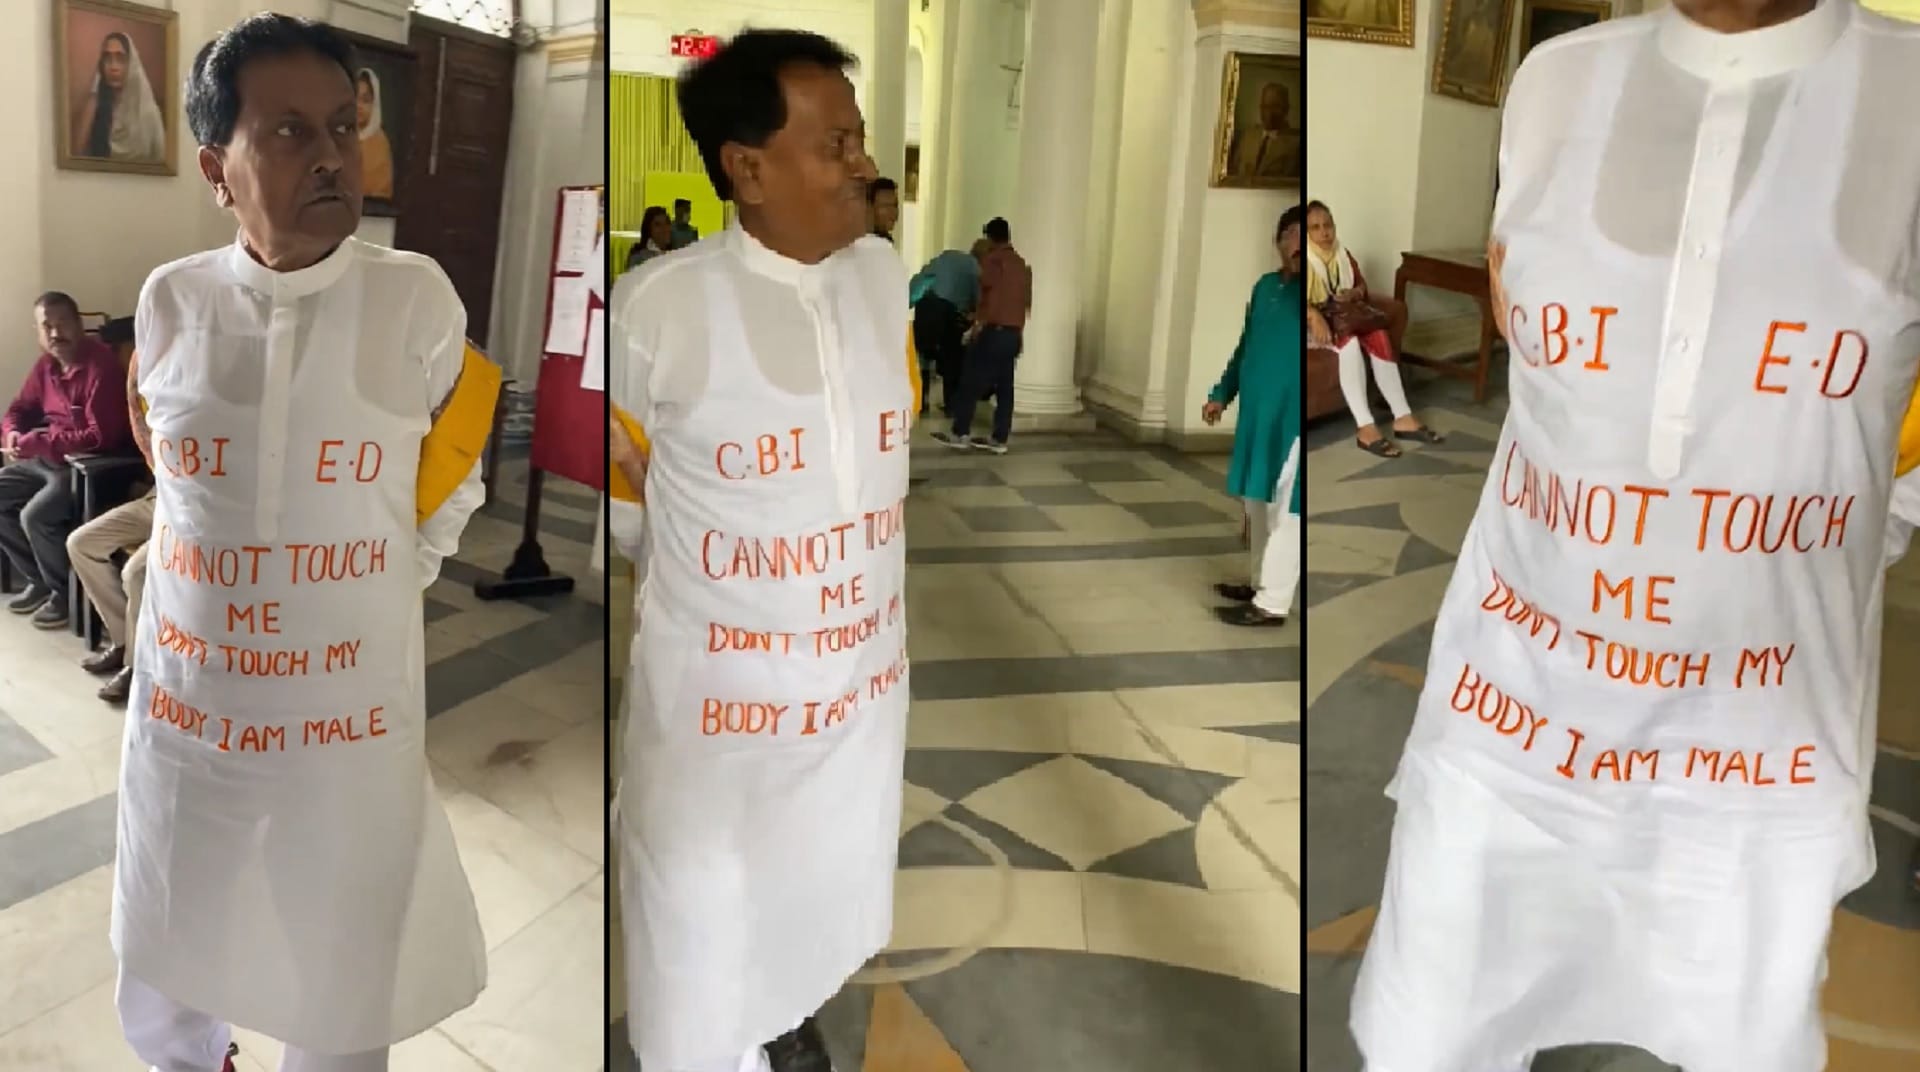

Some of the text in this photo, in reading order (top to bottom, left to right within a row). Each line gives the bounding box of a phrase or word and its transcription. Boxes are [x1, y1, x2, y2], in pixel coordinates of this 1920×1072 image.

[1502, 441, 1855, 553] CANNOT TOUCH
[159, 524, 387, 587] CANNOT TOUCH
[702, 522, 856, 581] CANNOT
[227, 602, 281, 634] ME
[820, 573, 865, 615] ME
[1592, 569, 1676, 624] ME
[217, 644, 309, 677] TOUCH
[325, 639, 361, 673] MY
[807, 608, 880, 658] TOUCH
[1576, 630, 1711, 689] TOUCH
[1735, 643, 1796, 689] MY
[151, 685, 387, 753] BODY I AM MALE
[701, 698, 788, 737] BODY
[801, 702, 822, 737] I
[824, 688, 859, 729] AM
[1450, 663, 1817, 786] BODY I AM MALE
